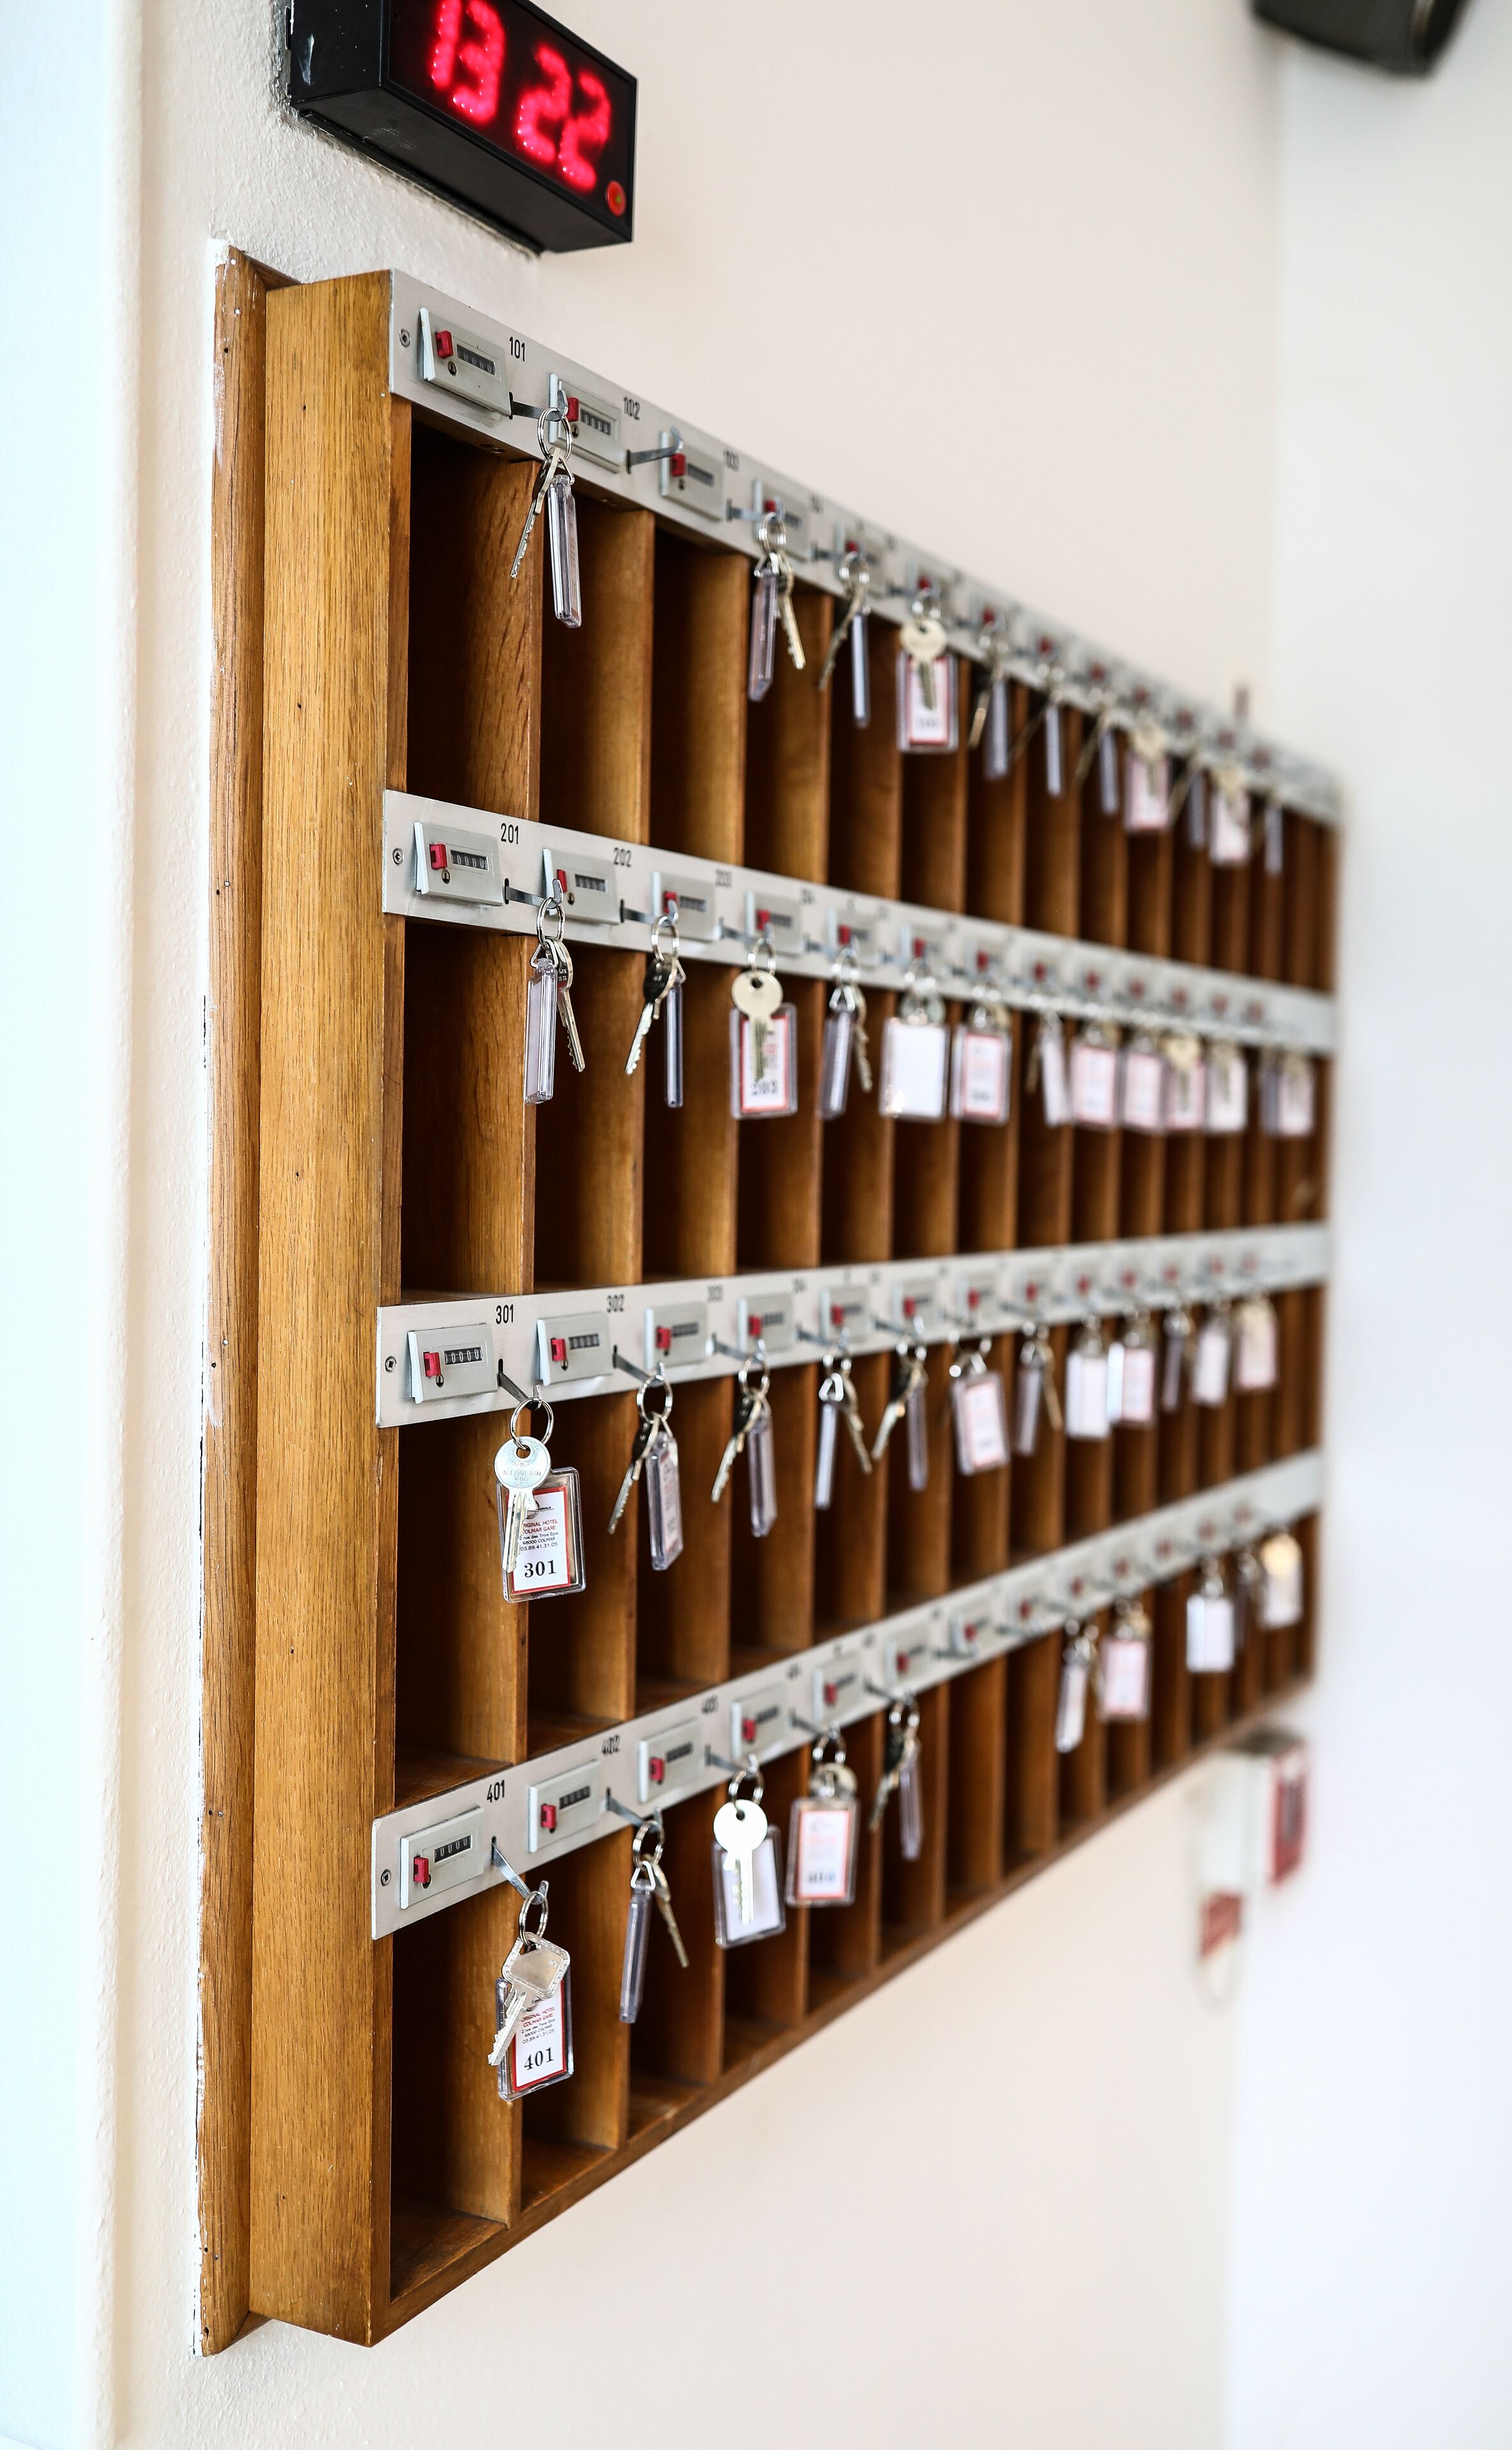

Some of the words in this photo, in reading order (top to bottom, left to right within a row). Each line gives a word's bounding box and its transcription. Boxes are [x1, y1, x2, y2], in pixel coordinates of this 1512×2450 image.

[430, 0, 505, 124] 13
[516, 43, 612, 190] 22
[509, 336, 525, 362] 101
[623, 396, 641, 420] 102
[501, 822, 519, 845] 201
[495, 1304, 514, 1325] 301
[524, 1559, 556, 1578] 301
[486, 1779, 505, 1802] 401
[524, 2047, 555, 2070] 401
